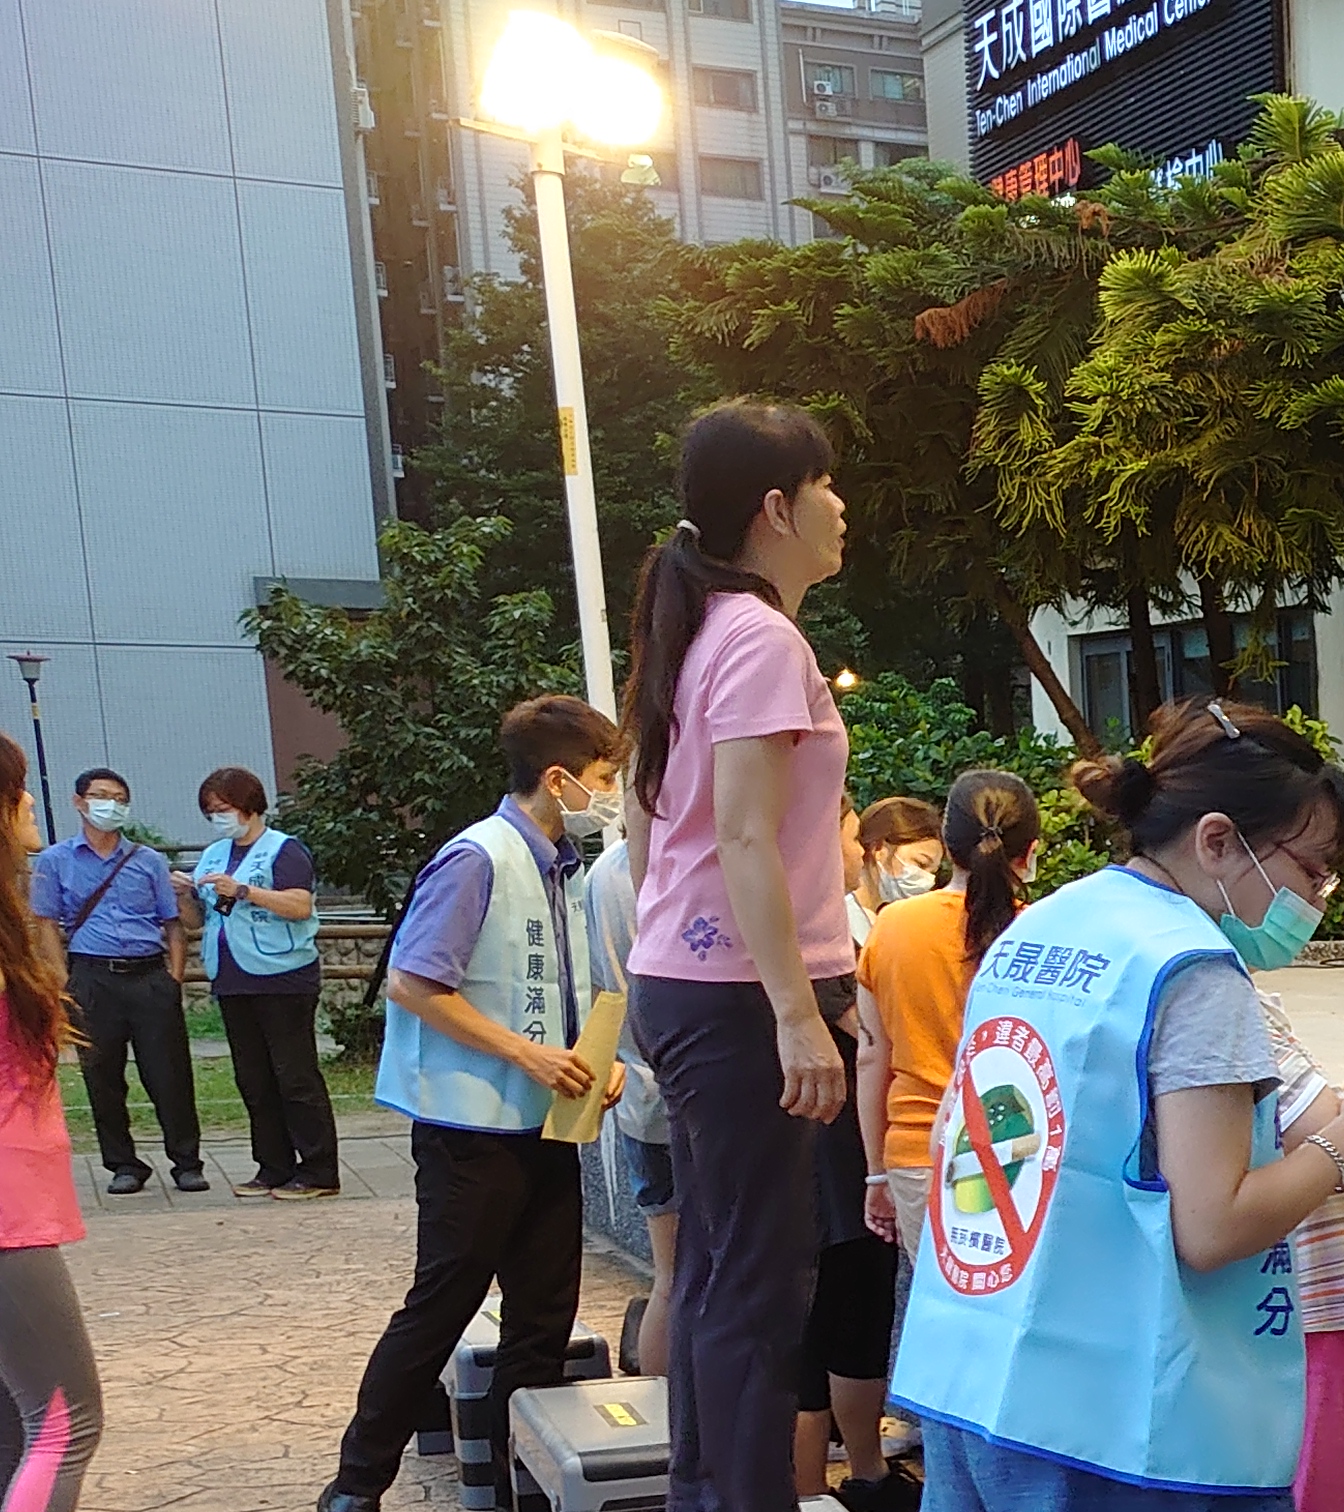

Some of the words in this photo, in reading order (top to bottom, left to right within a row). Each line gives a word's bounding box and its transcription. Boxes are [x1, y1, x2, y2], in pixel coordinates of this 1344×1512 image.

[976, 90, 1023, 137] Ten-Chen
[1027, 38, 1101, 106] International
[1104, 2, 1159, 61] Medical
[1164, 0, 1212, 26] Cen
[523, 918, 547, 1045] 健康滿分
[980, 940, 1111, 994] 天晟醫院
